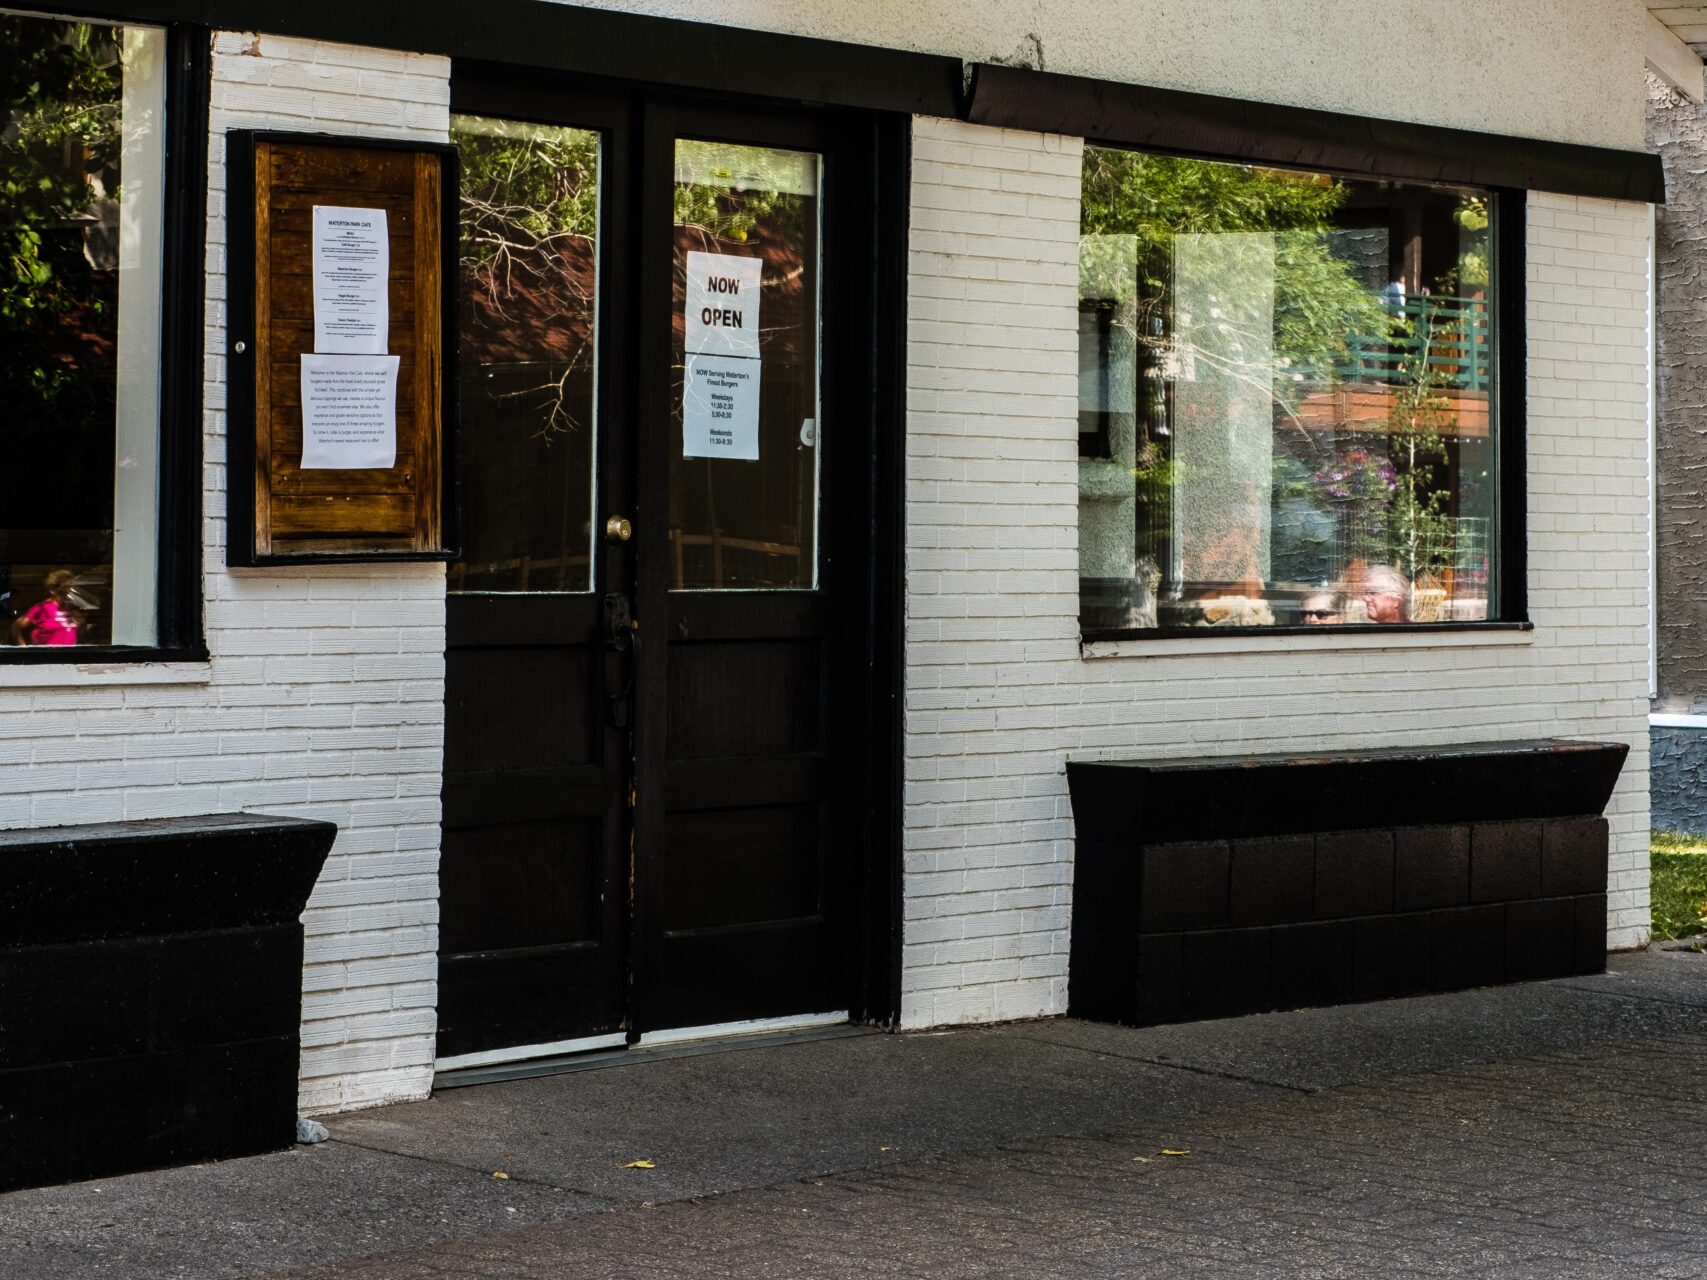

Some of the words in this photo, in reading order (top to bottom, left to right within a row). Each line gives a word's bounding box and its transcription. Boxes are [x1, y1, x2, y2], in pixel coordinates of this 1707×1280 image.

[708, 276, 740, 294] NOW
[702, 308, 742, 328] OPEN
[709, 370, 725, 379] Serving
[721, 380, 738, 388] Burgers
[712, 394, 733, 402] Weekdays
